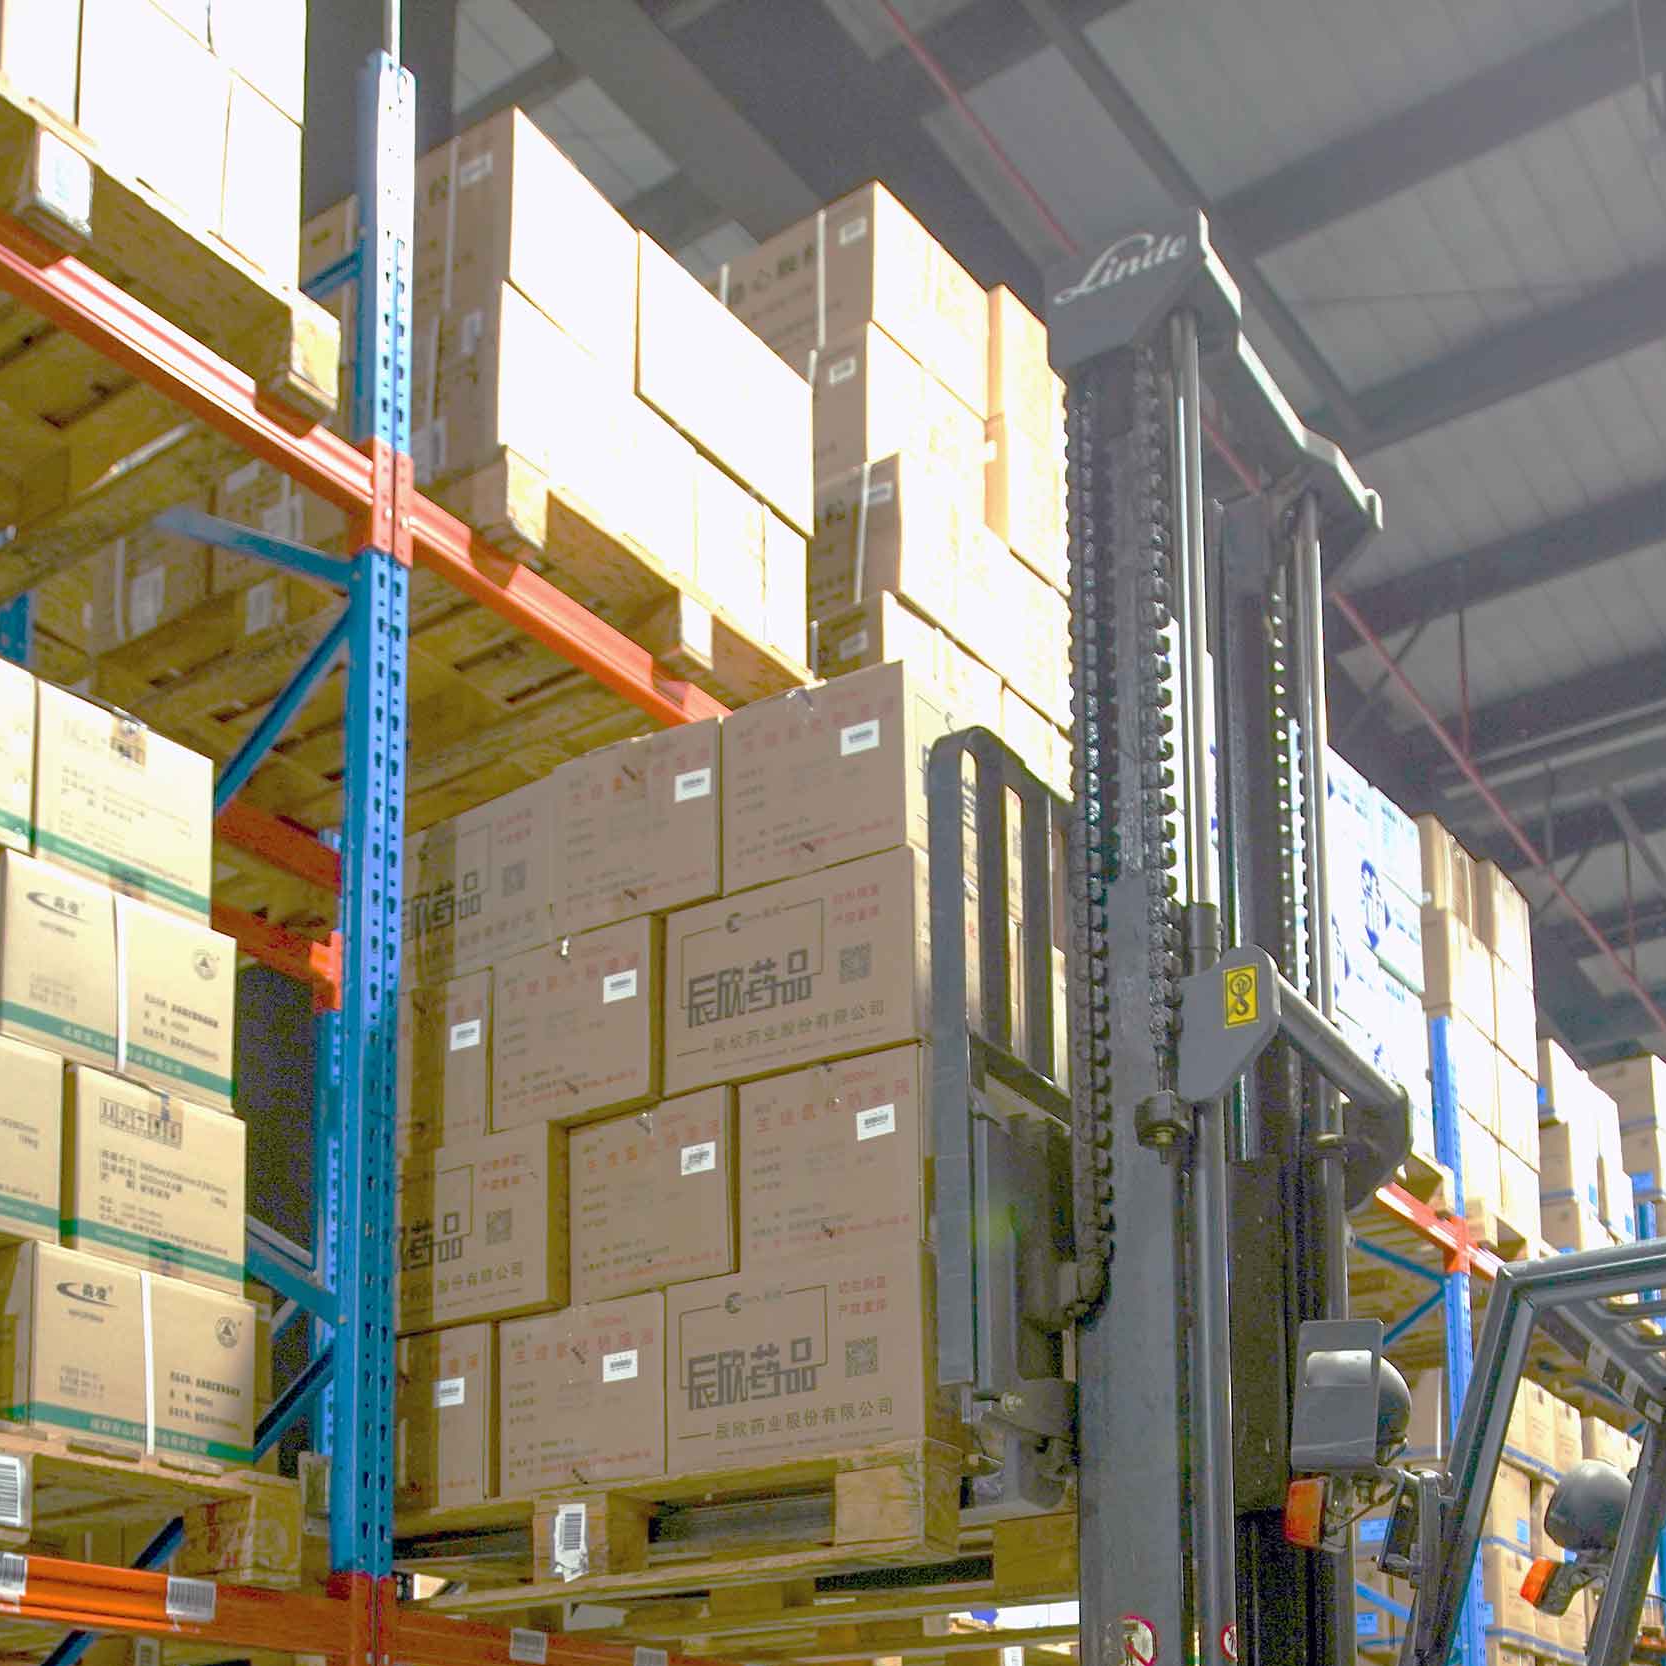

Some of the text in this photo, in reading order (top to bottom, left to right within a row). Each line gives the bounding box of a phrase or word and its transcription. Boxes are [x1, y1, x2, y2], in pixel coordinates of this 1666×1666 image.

[1053, 234, 1188, 305] Linde
[715, 1396, 895, 1441] 辰欣药业股份有限公司
